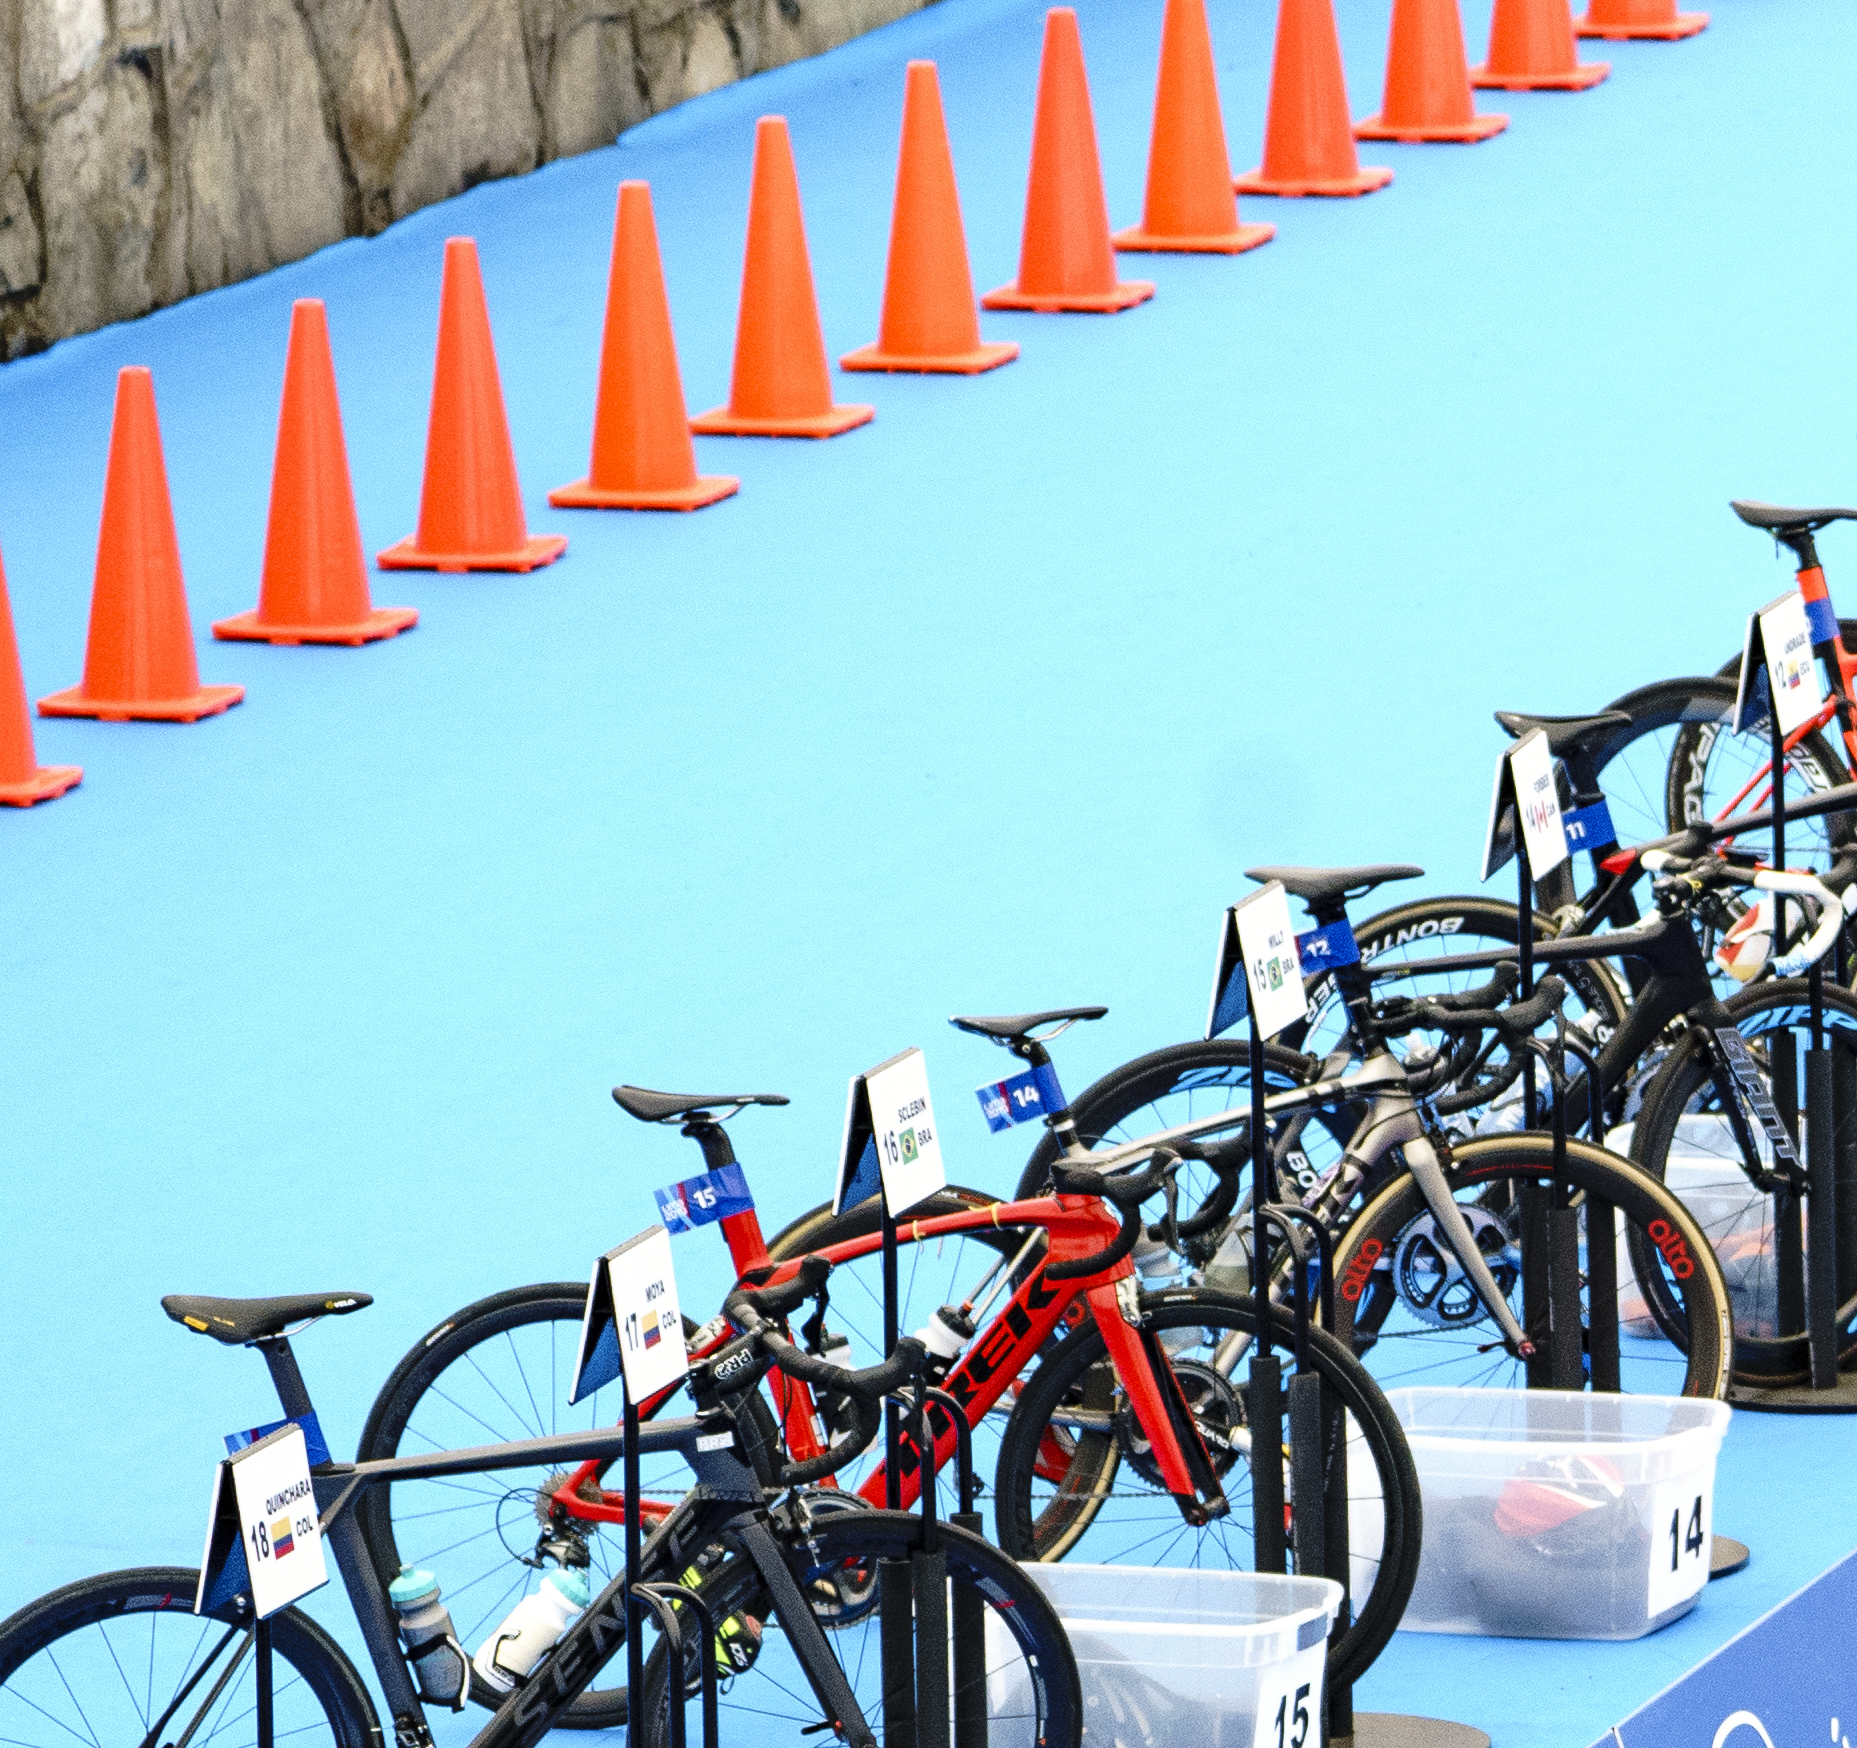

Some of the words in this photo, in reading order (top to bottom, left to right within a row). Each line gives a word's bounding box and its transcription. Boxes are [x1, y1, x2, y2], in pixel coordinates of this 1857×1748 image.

[1565, 821, 1586, 840] 11
[1306, 940, 1330, 957] 12
[1253, 956, 1267, 993] 15
[1281, 957, 1294, 975] BRA
[1013, 1086, 1040, 1107] 14
[883, 1130, 898, 1166] 16
[917, 1127, 933, 1147] BRA
[693, 1188, 716, 1209] 15
[645, 1280, 666, 1303] MOYA
[625, 1312, 639, 1351] 17
[662, 1310, 677, 1330] COL
[266, 1479, 311, 1515] QUINCHARA
[251, 1521, 269, 1561] 18
[296, 1516, 314, 1537] COL
[1669, 1494, 1704, 1572] 14
[513, 1508, 697, 1728] SENE
